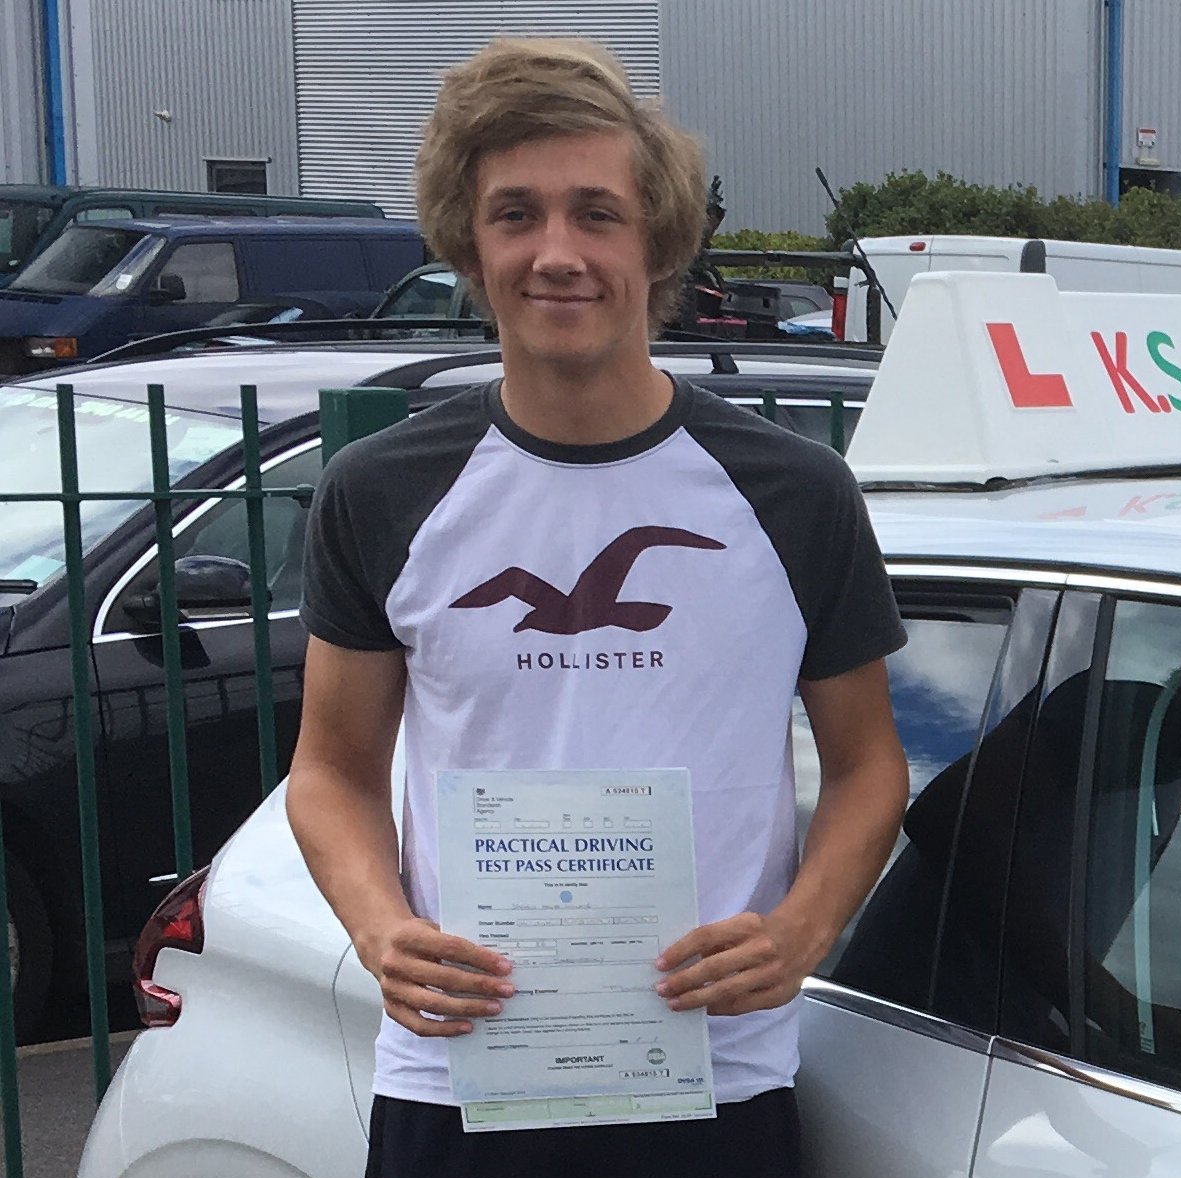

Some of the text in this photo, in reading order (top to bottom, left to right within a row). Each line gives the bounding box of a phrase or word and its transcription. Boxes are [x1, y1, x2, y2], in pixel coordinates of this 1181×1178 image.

[986, 322, 1074, 407] L
[516, 650, 664, 670] HOLLISTER
[475, 837, 654, 853] PRACTICAL DRIVING
[476, 858, 656, 873] TEST PASS CERTIFICATE
[555, 1054, 605, 1065] IMPORTANT
